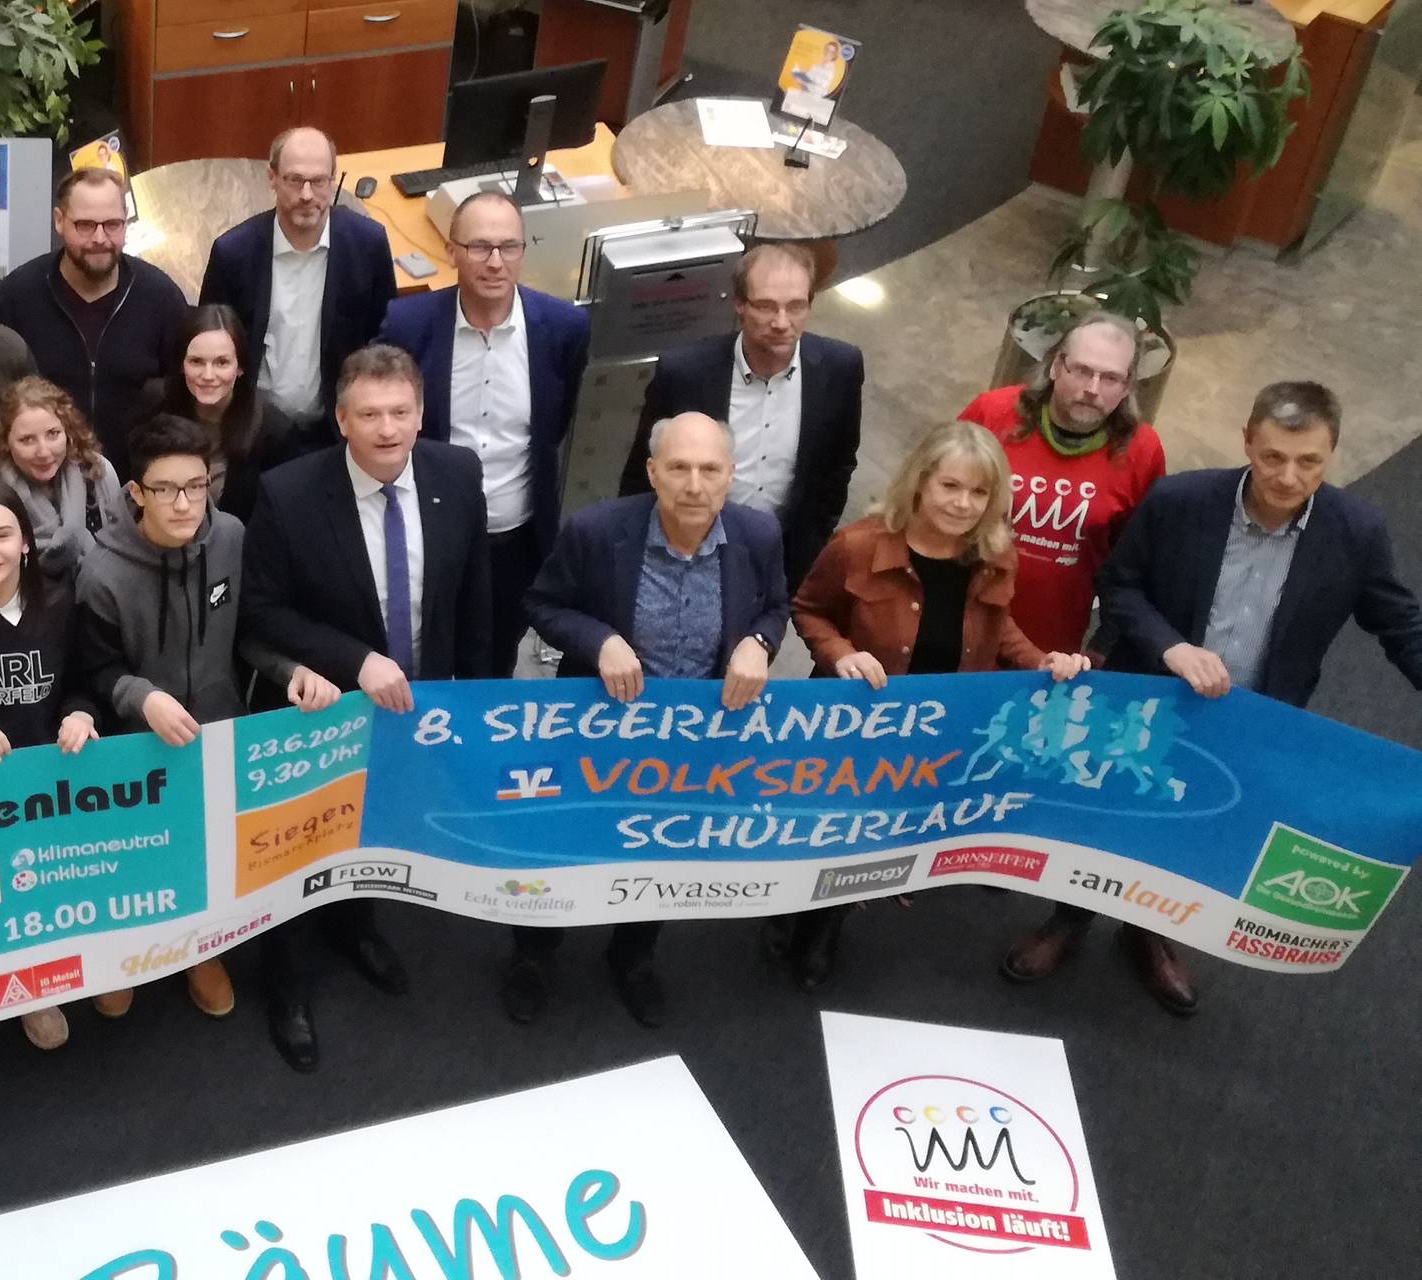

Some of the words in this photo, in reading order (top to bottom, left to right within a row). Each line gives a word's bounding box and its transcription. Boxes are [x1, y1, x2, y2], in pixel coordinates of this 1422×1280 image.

[247, 716, 367, 762] 23.6.2020
[414, 707, 463, 745] 8.
[484, 694, 947, 743] SIEGERLÄNDER
[247, 760, 312, 792] 9.30
[319, 743, 363, 769] Uhr
[579, 750, 962, 797] VOLKSBANK
[250, 802, 355, 853] Siegen
[616, 792, 1035, 849] SCHÜLERLAUF
[38, 828, 170, 862] klimaneutral
[1291, 844, 1351, 872] powered
[40, 860, 119, 886] inklusiv
[607, 877, 779, 905] 57wasser
[834, 863, 911, 886] innogy
[1263, 870, 1370, 913] AOK
[4, 901, 97, 942] 18.00
[109, 889, 177, 920] UHR
[464, 891, 498, 907] Echt
[197, 913, 273, 955] BÜRGER
[1226, 931, 1343, 964] FASSBRAUSE
[914, 1176, 940, 1191] Wir
[945, 1181, 1003, 1199] machen
[1008, 1187, 1039, 1204] mit.
[80, 1167, 648, 1280] äume
[882, 1198, 997, 1232] Inklusion
[1003, 1213, 1071, 1242] läuft!
